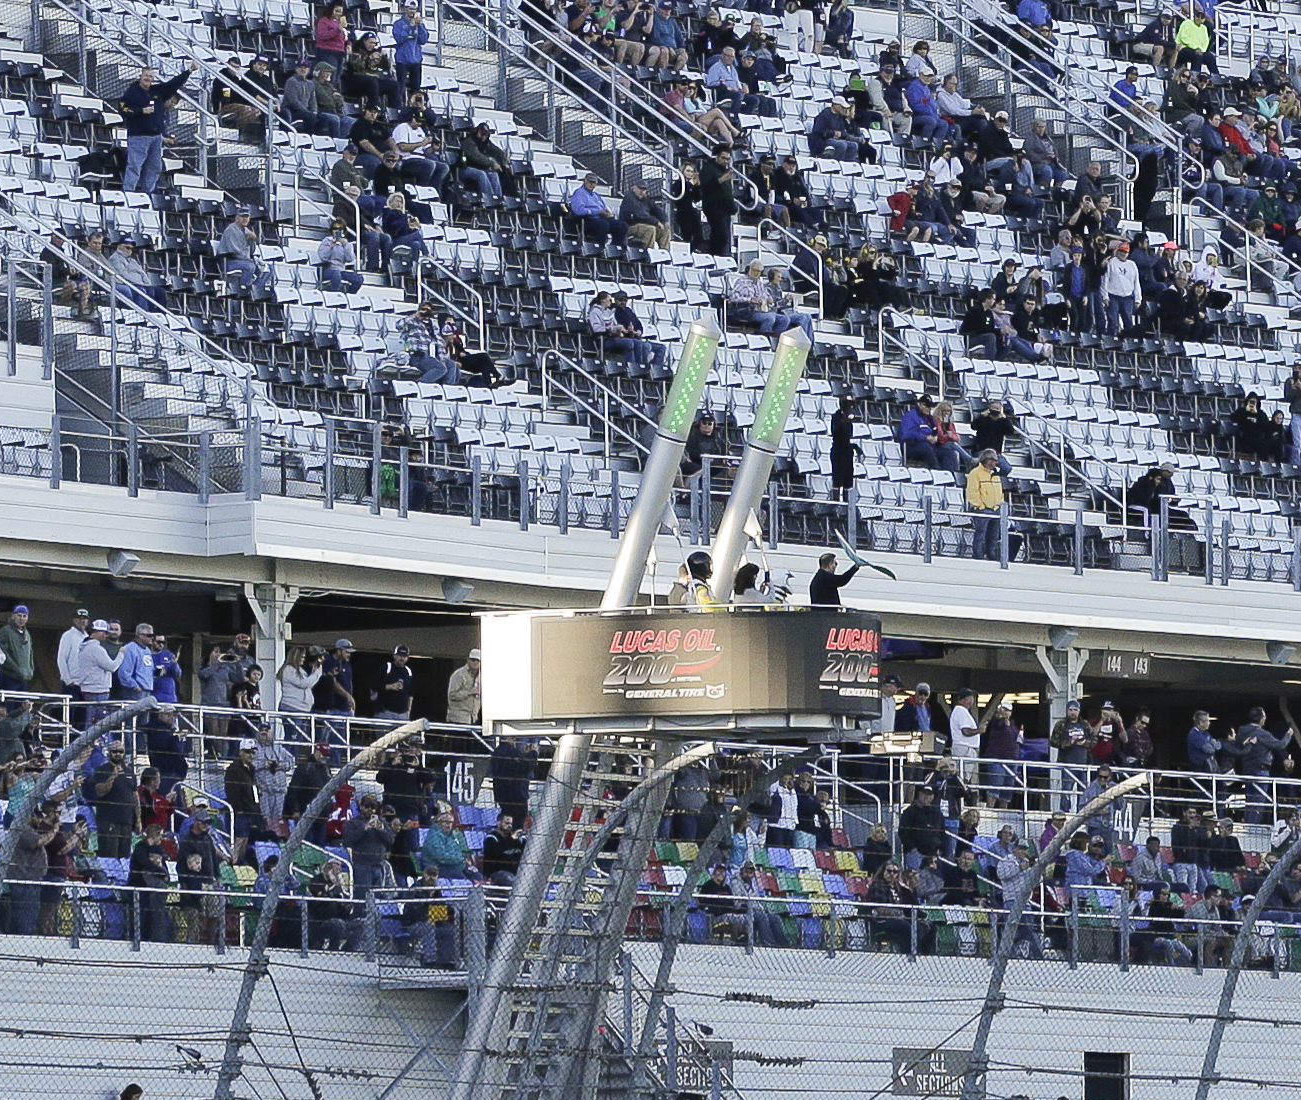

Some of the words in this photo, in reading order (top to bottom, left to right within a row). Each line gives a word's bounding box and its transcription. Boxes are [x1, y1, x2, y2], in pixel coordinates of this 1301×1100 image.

[609, 629, 681, 653] LUCAS
[684, 628, 717, 652] OIL
[603, 654, 679, 685] 200
[820, 652, 874, 682] 200
[1107, 655, 1122, 673] 144
[1133, 657, 1148, 675] 143
[625, 688, 677, 698] GENERAL
[679, 687, 705, 698] TIRE
[444, 761, 474, 804] 145
[1113, 802, 1134, 842] 44
[676, 1066, 728, 1088] SECTIOS
